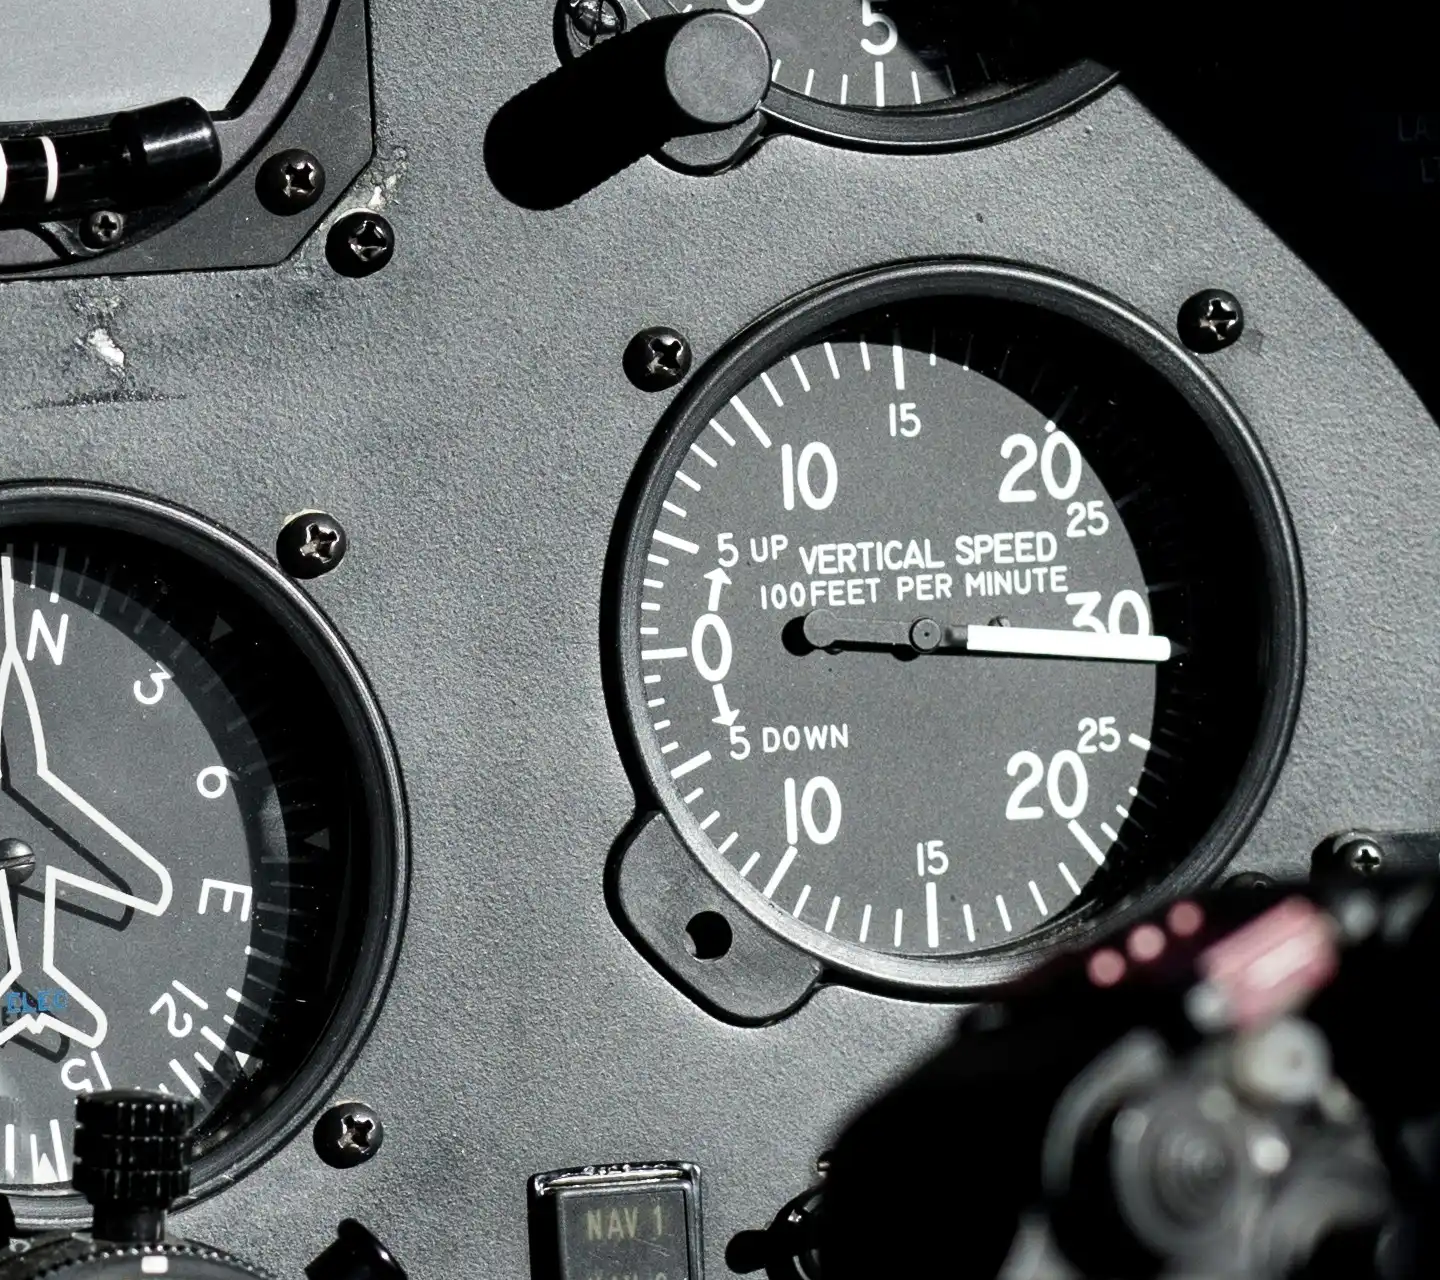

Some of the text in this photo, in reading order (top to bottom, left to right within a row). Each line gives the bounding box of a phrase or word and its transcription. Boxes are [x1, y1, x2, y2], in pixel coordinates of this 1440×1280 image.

[889, 403, 921, 438] 15
[782, 441, 838, 510] 10
[999, 431, 1082, 503] 20
[1066, 501, 1109, 538] 25
[717, 533, 788, 567] 5 UP
[800, 531, 1058, 576] VERTICAL SPEED
[897, 573, 954, 602] PER
[965, 566, 1069, 597] MINUTE
[1065, 590, 1150, 636] 30
[27, 609, 69, 664] N
[692, 613, 732, 683] 0
[133, 662, 174, 705] 3
[729, 725, 849, 760] 5 DOWN
[1078, 717, 1121, 754] 25
[196, 765, 235, 799] 6
[1005, 749, 1088, 820] 20
[786, 777, 842, 844] 10
[917, 840, 949, 876] 15
[198, 879, 253, 921] E
[7, 990, 67, 1014] ELEC
[150, 980, 208, 1037] 12
[587, 1205, 663, 1240] NAV 1
